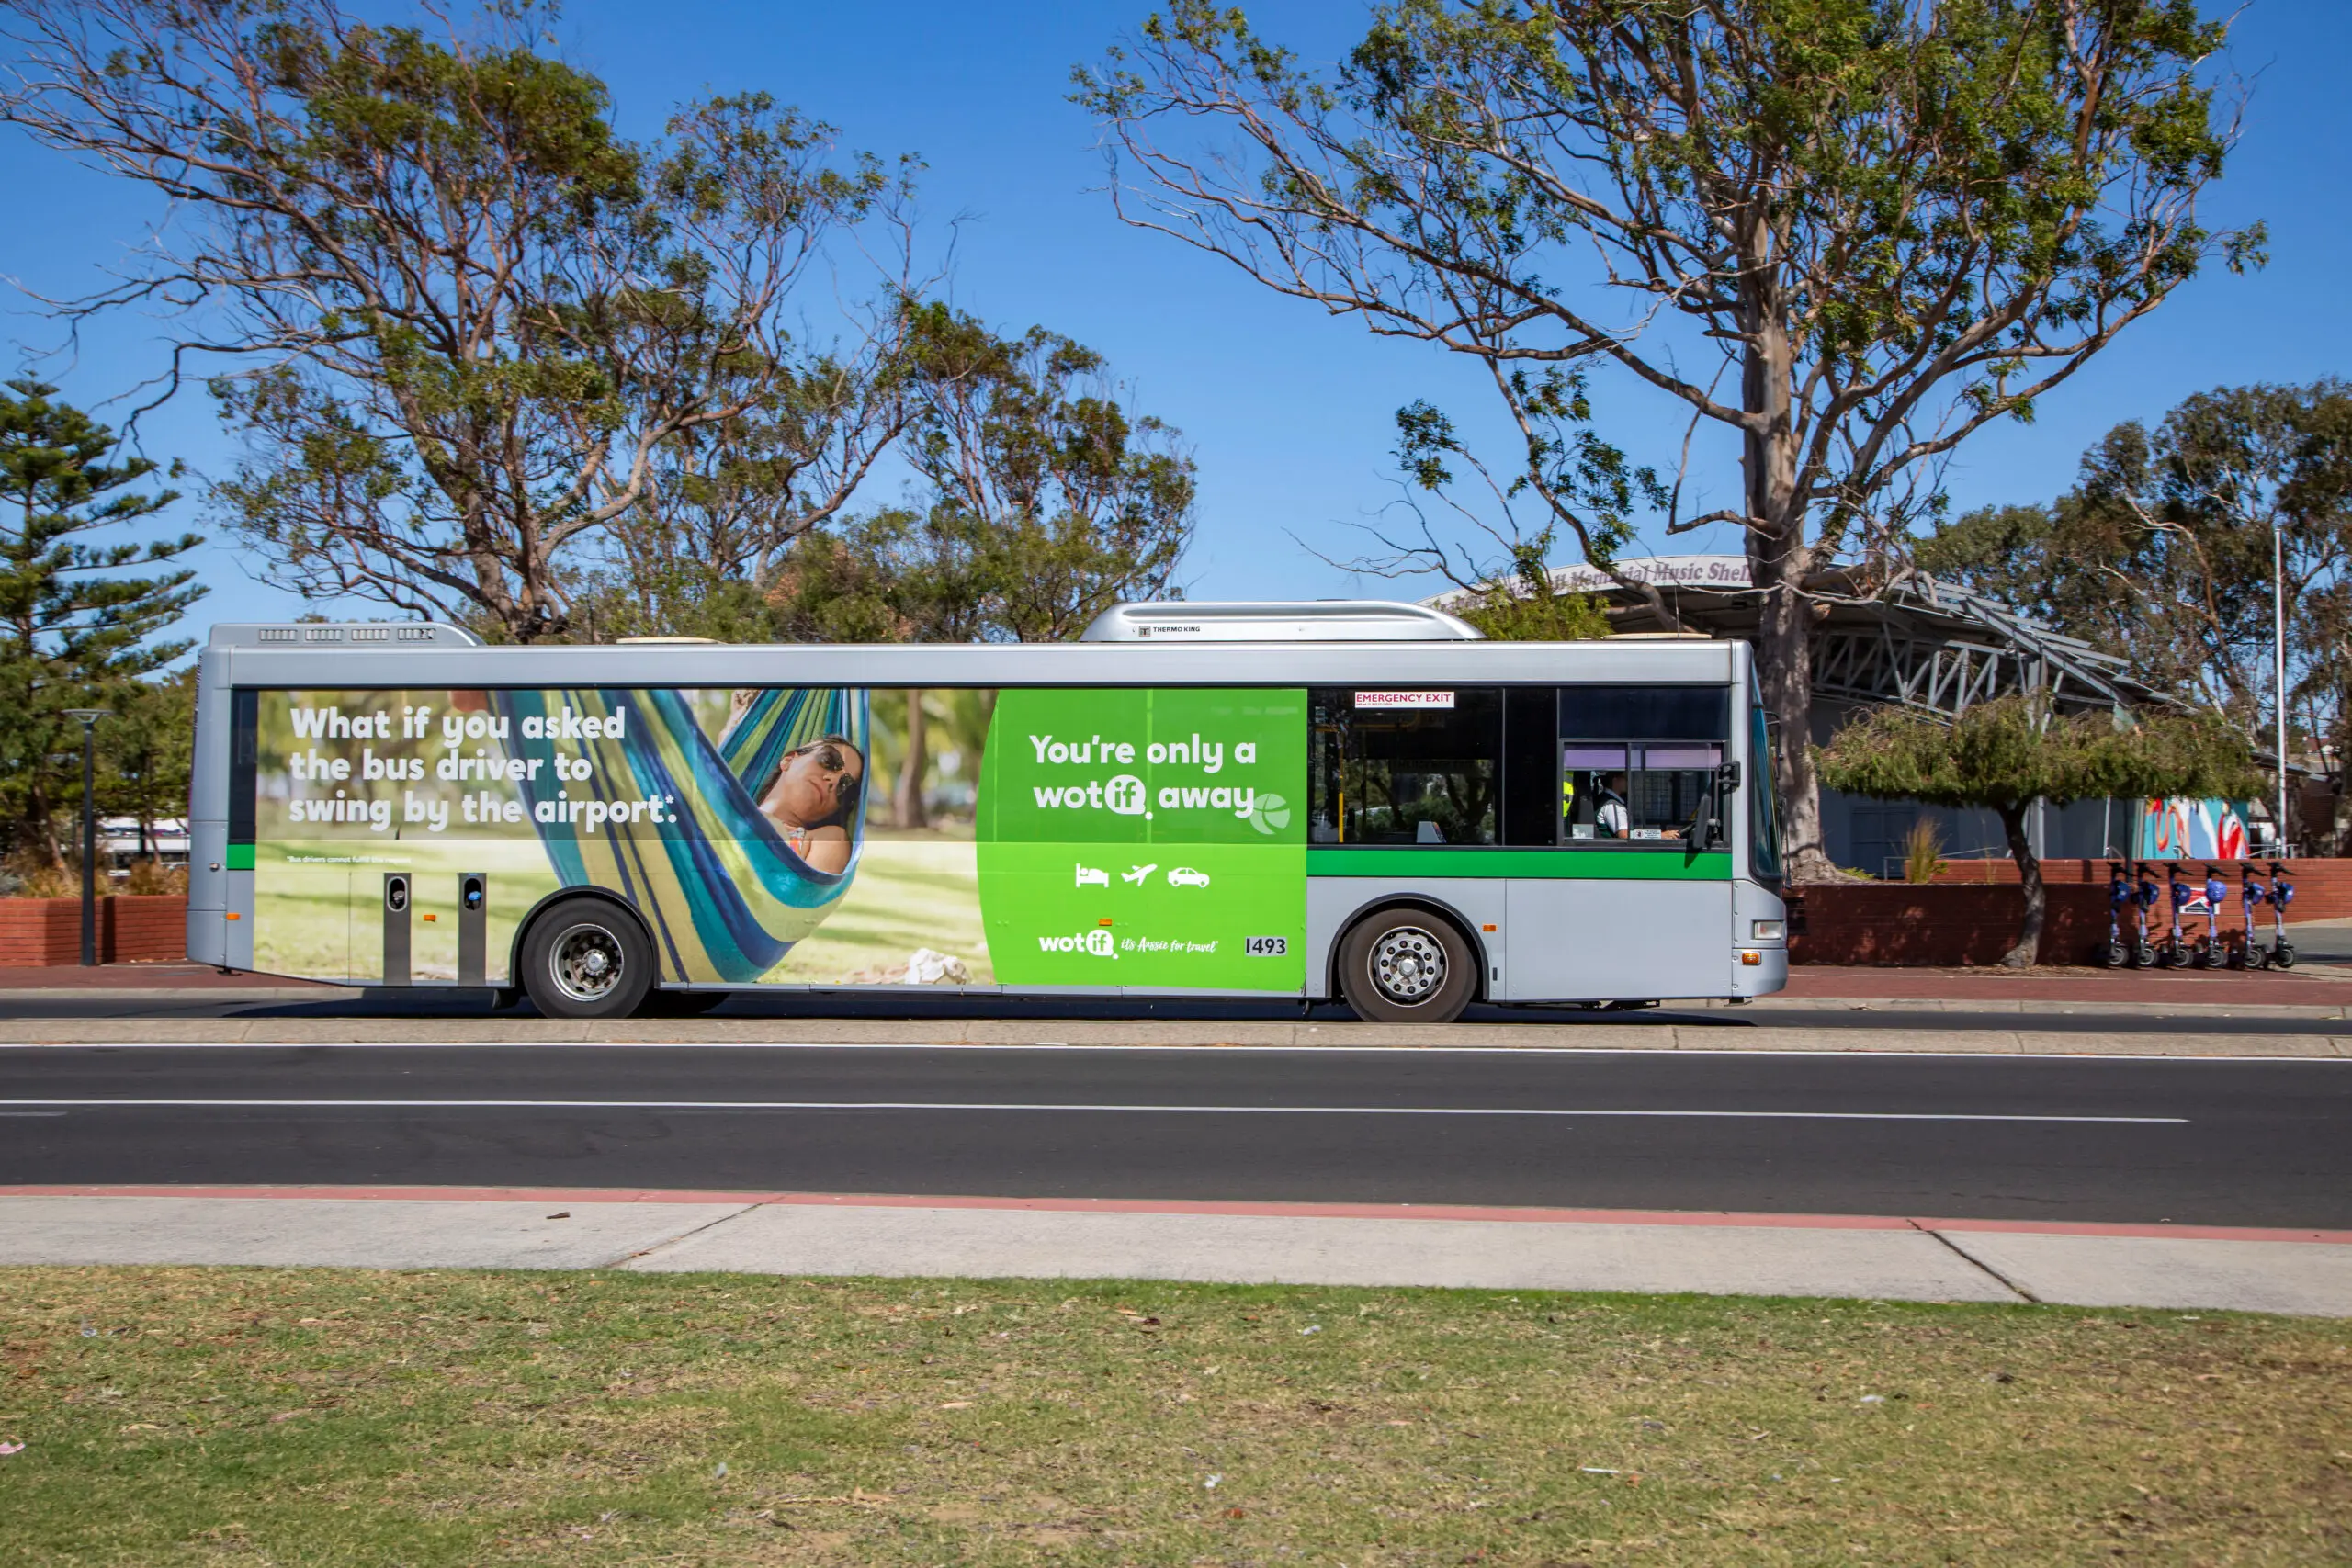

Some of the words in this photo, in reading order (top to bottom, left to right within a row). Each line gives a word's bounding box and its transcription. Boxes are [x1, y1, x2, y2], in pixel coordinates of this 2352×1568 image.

[1569, 564, 1650, 585] Memial
[1654, 564, 1704, 581] Music
[1356, 694, 1423, 703] EMERGENCY
[1425, 694, 1451, 703] EXIT
[290, 706, 390, 739] What
[403, 705, 432, 739] if
[443, 716, 509, 749] you
[521, 706, 625, 739] asked
[289, 749, 351, 780] the
[363, 749, 424, 780] bus
[436, 748, 544, 781] driver
[554, 752, 593, 781] to
[1029, 735, 1136, 763] You're
[1147, 733, 1223, 773] only
[1234, 742, 1256, 763] a
[289, 790, 391, 831] swing
[404, 791, 448, 831] by
[462, 791, 522, 822] the
[1159, 787, 1254, 818] away
[1039, 929, 1118, 960] wotif
[1137, 936, 1169, 953] Aussie
[1170, 940, 1185, 953] for
[1246, 938, 1286, 954] 1493
